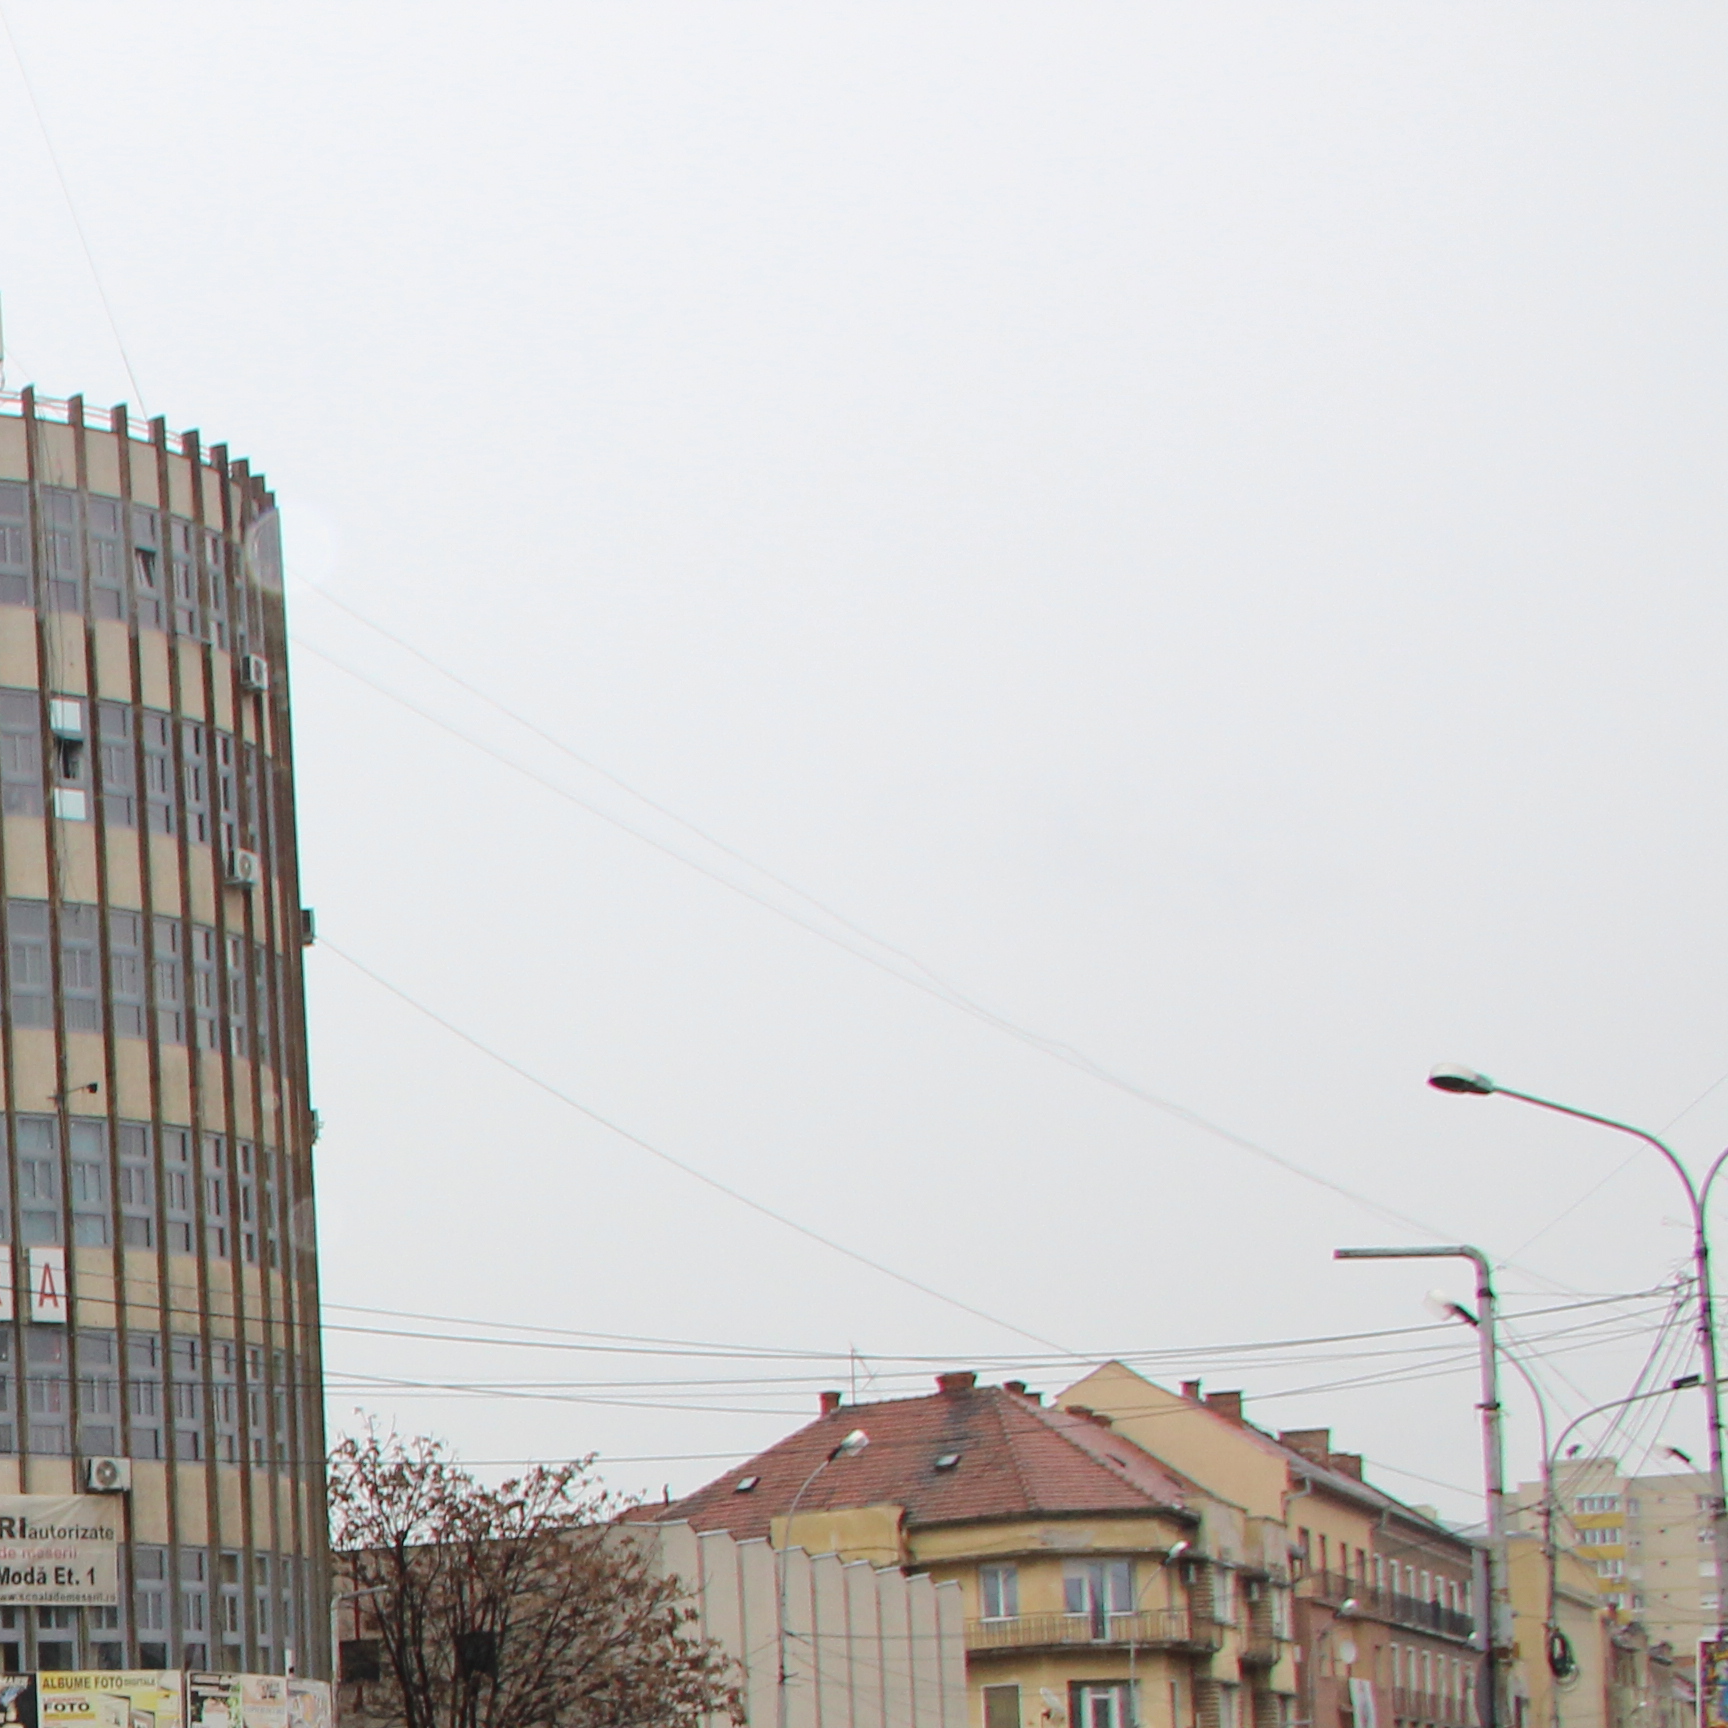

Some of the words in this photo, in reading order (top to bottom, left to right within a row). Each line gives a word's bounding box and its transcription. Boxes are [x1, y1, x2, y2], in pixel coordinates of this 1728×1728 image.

[28, 1523, 115, 1541] autorizate
[54, 1566, 80, 1586] Et.
[86, 1567, 96, 1586] 1
[43, 1677, 91, 1690] ALBUME
[94, 1676, 123, 1689] FOTO
[44, 1701, 90, 1713] FOTO
